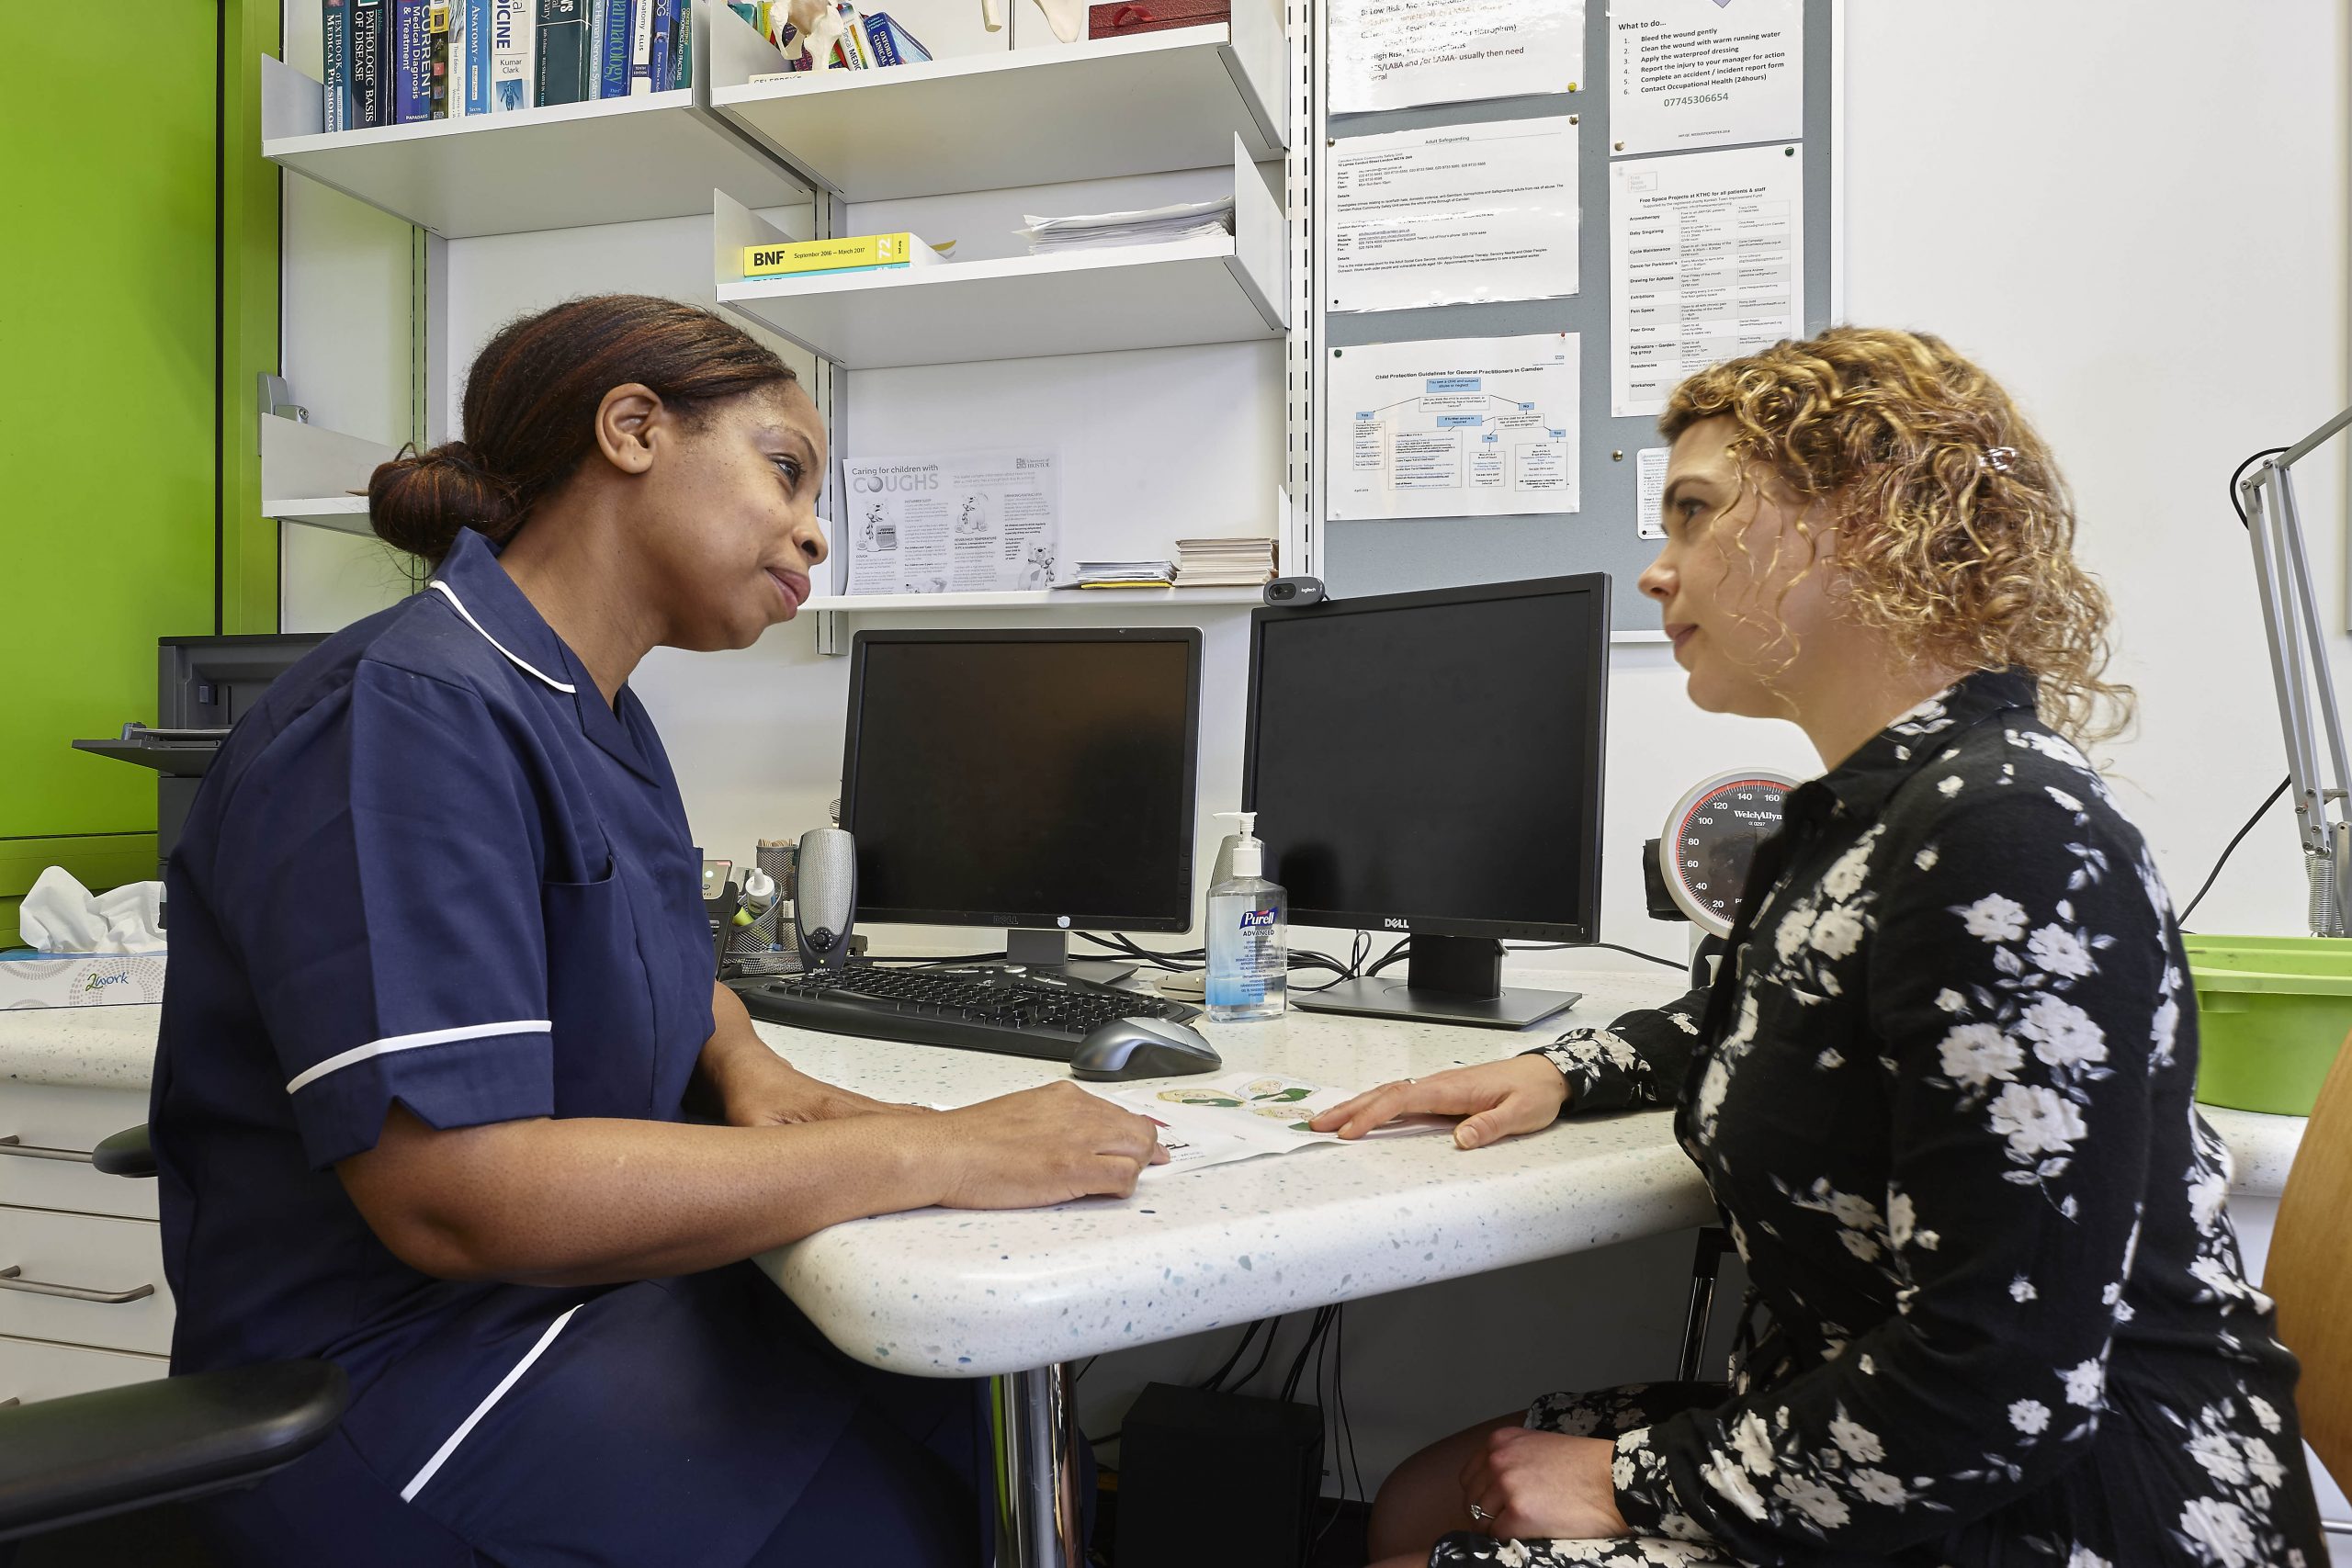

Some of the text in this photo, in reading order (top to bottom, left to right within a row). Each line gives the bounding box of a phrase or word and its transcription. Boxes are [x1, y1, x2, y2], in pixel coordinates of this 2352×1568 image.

[471, 6, 481, 55] ANATOMY
[496, 0, 511, 49] ICINE
[1618, 22, 1639, 30] What
[326, 15, 335, 65] MEDICAL
[402, 6, 412, 71] & Treatment
[1672, 40, 1695, 49] wound
[1733, 33, 1759, 42] running
[1673, 30, 1696, 39] wound
[1696, 28, 1718, 37] gently
[355, 11, 364, 82] OF DISEASE
[421, 5, 431, 98] CURRENT
[873, 34, 888, 65] CLINICAL
[879, 30, 893, 58] OXFORD
[411, 6, 421, 99] Medical Diagnosis
[590, 10, 602, 99] Human Nervous System
[849, 49, 862, 71] MEDIC
[1459, 51, 1486, 61] usually
[1486, 50, 1504, 58] then
[1505, 47, 1524, 56] need
[1640, 55, 1660, 63] Apply
[1673, 49, 1711, 60] waterproof
[1712, 46, 1739, 55] dressing
[365, 10, 375, 122] PATHOLOGIC BASIS
[500, 59, 523, 67] Kumar
[502, 66, 520, 74] Clark
[1640, 65, 1663, 74] Report
[1677, 61, 1696, 71] injury
[1705, 58, 1721, 67] your
[1722, 54, 1751, 64] manager
[335, 73, 343, 83] of
[1640, 73, 1672, 85] Complete
[1682, 70, 1711, 78] accident
[1711, 68, 1716, 76] /
[1716, 65, 1744, 74] incident
[1745, 63, 1767, 73] report
[1768, 61, 1784, 69] form
[1667, 80, 1710, 91] Occupational
[1711, 77, 1734, 85] Health
[1735, 73, 1767, 85] (24hours)
[1663, 92, 1729, 107] 07745306654
[1438, 135, 1470, 145] Safeguarding
[878, 238, 891, 258] 72
[753, 250, 786, 266] BNF
[852, 467, 877, 476] Caring
[890, 465, 922, 473] children
[853, 473, 939, 494] COUGHS
[1736, 793, 1753, 801] 140
[1764, 794, 1781, 802] 160
[1713, 802, 1728, 810] 120
[1698, 817, 1713, 825] 100
[1734, 809, 1782, 822] WelchAllyn
[1688, 838, 1700, 846] 80
[1687, 860, 1699, 868] 60
[1695, 882, 1708, 890] 40
[1712, 899, 1724, 908] 20
[1244, 911, 1274, 925] Purell
[1384, 918, 1409, 929] DELL
[85, 972, 130, 992] 2work
